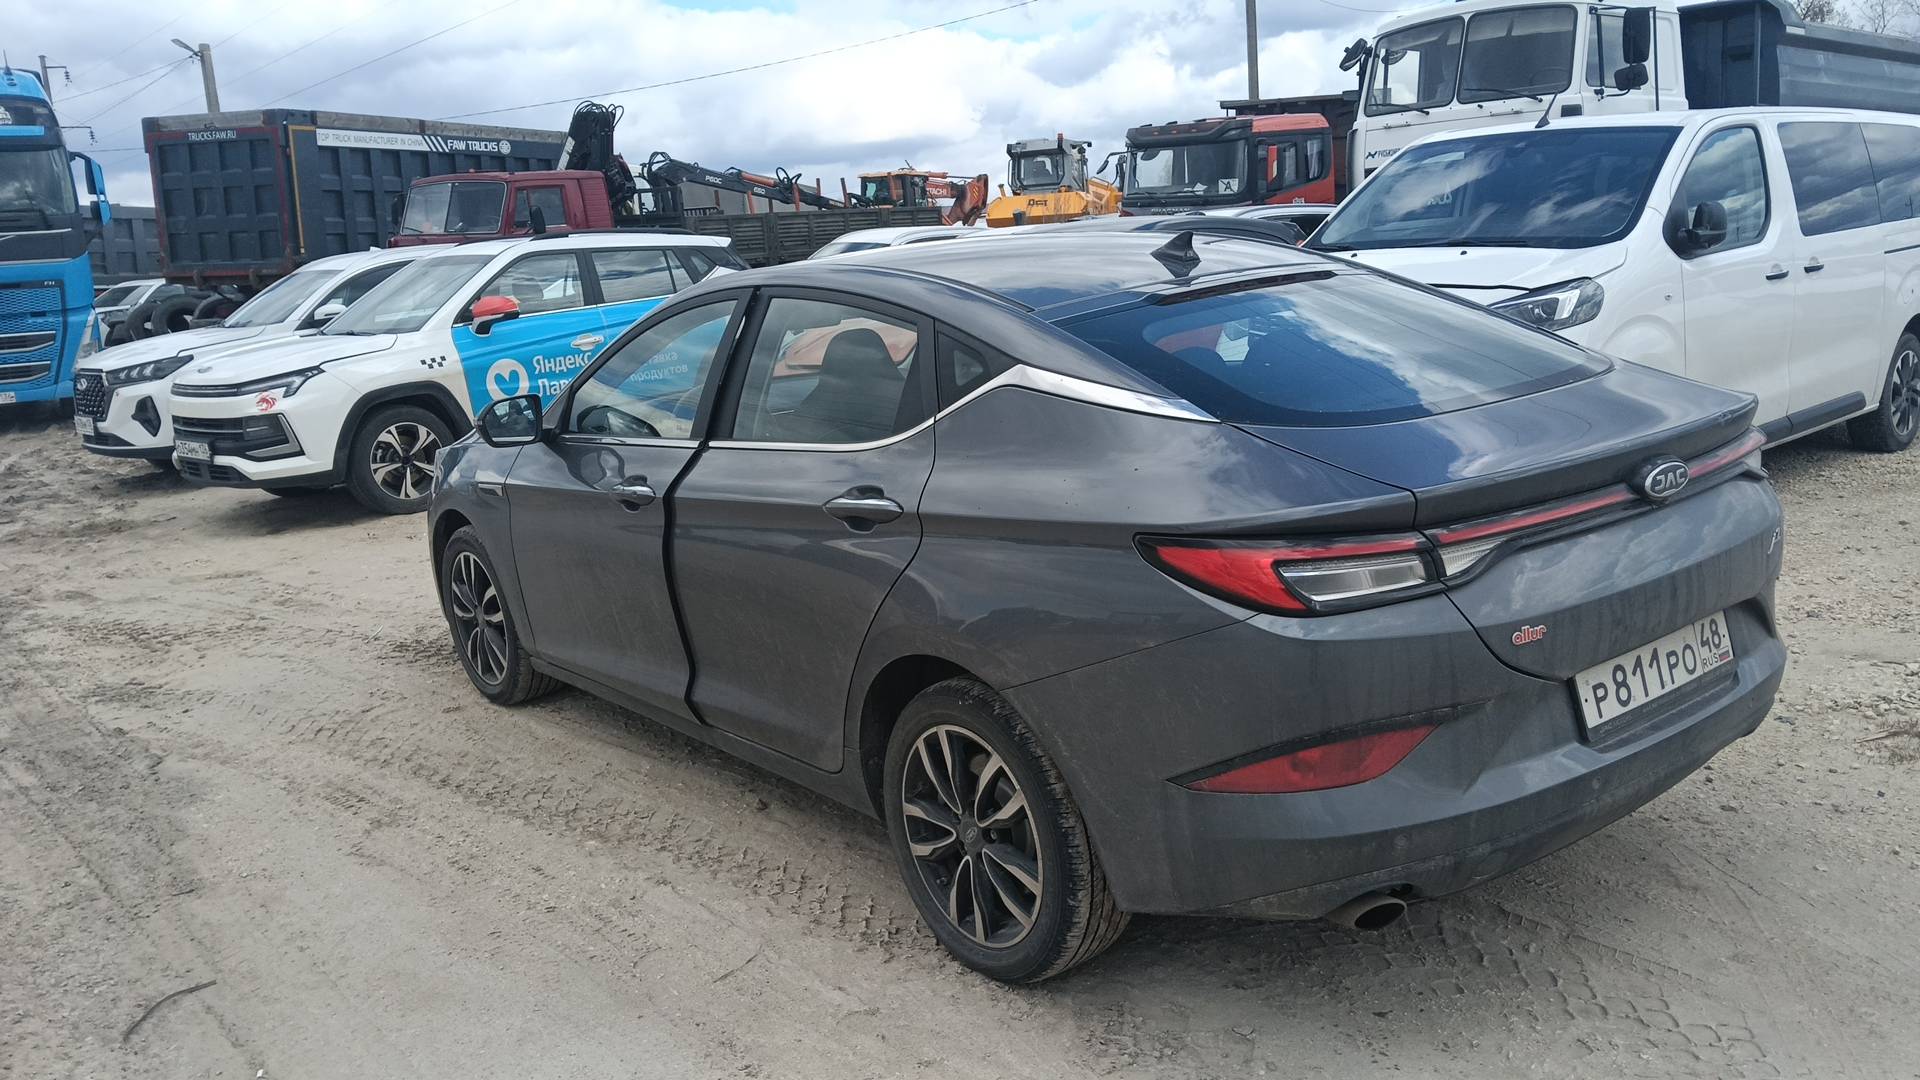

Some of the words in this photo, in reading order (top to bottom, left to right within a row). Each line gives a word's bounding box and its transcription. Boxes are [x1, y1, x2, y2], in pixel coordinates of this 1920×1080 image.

[188, 130, 237, 141] TRUCKS.FAW.RU
[317, 132, 330, 142] TOP
[331, 133, 351, 143] TRUCK
[353, 135, 399, 146] MANUFACTURER
[407, 138, 424, 147] CHINA
[447, 140, 467, 150] FAW
[467, 141, 498, 152] TRUCKS
[532, 352, 592, 375] Яндекс
[629, 363, 689, 384] продуктов
[1655, 469, 1686, 491] JAC
[1511, 624, 1547, 646] allur
[1700, 617, 1722, 653] 48
[1702, 652, 1719, 669] RUS
